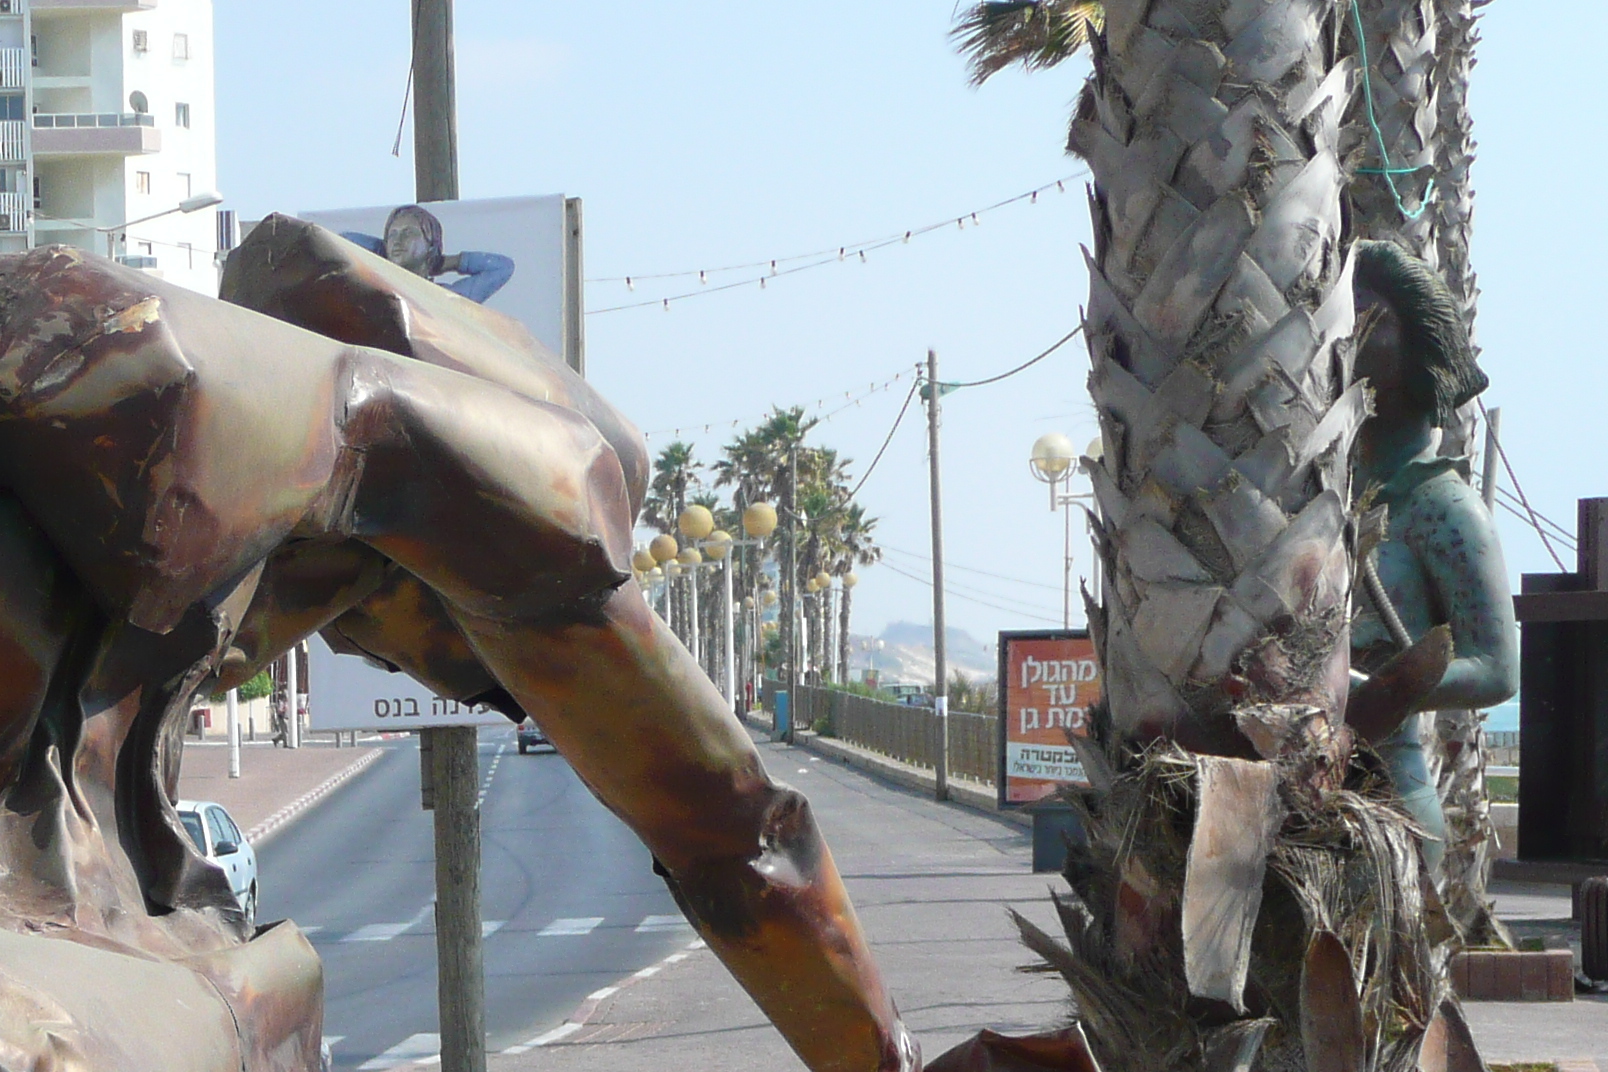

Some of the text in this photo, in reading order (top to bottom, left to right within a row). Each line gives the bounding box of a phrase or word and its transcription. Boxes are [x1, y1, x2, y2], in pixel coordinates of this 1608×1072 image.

[1021, 655, 1097, 689] מהגולן
[1042, 684, 1077, 706] עד
[374, 698, 420, 718] בנס
[1020, 706, 1089, 735] מת גן
[1020, 749, 1078, 763] לקטרה
